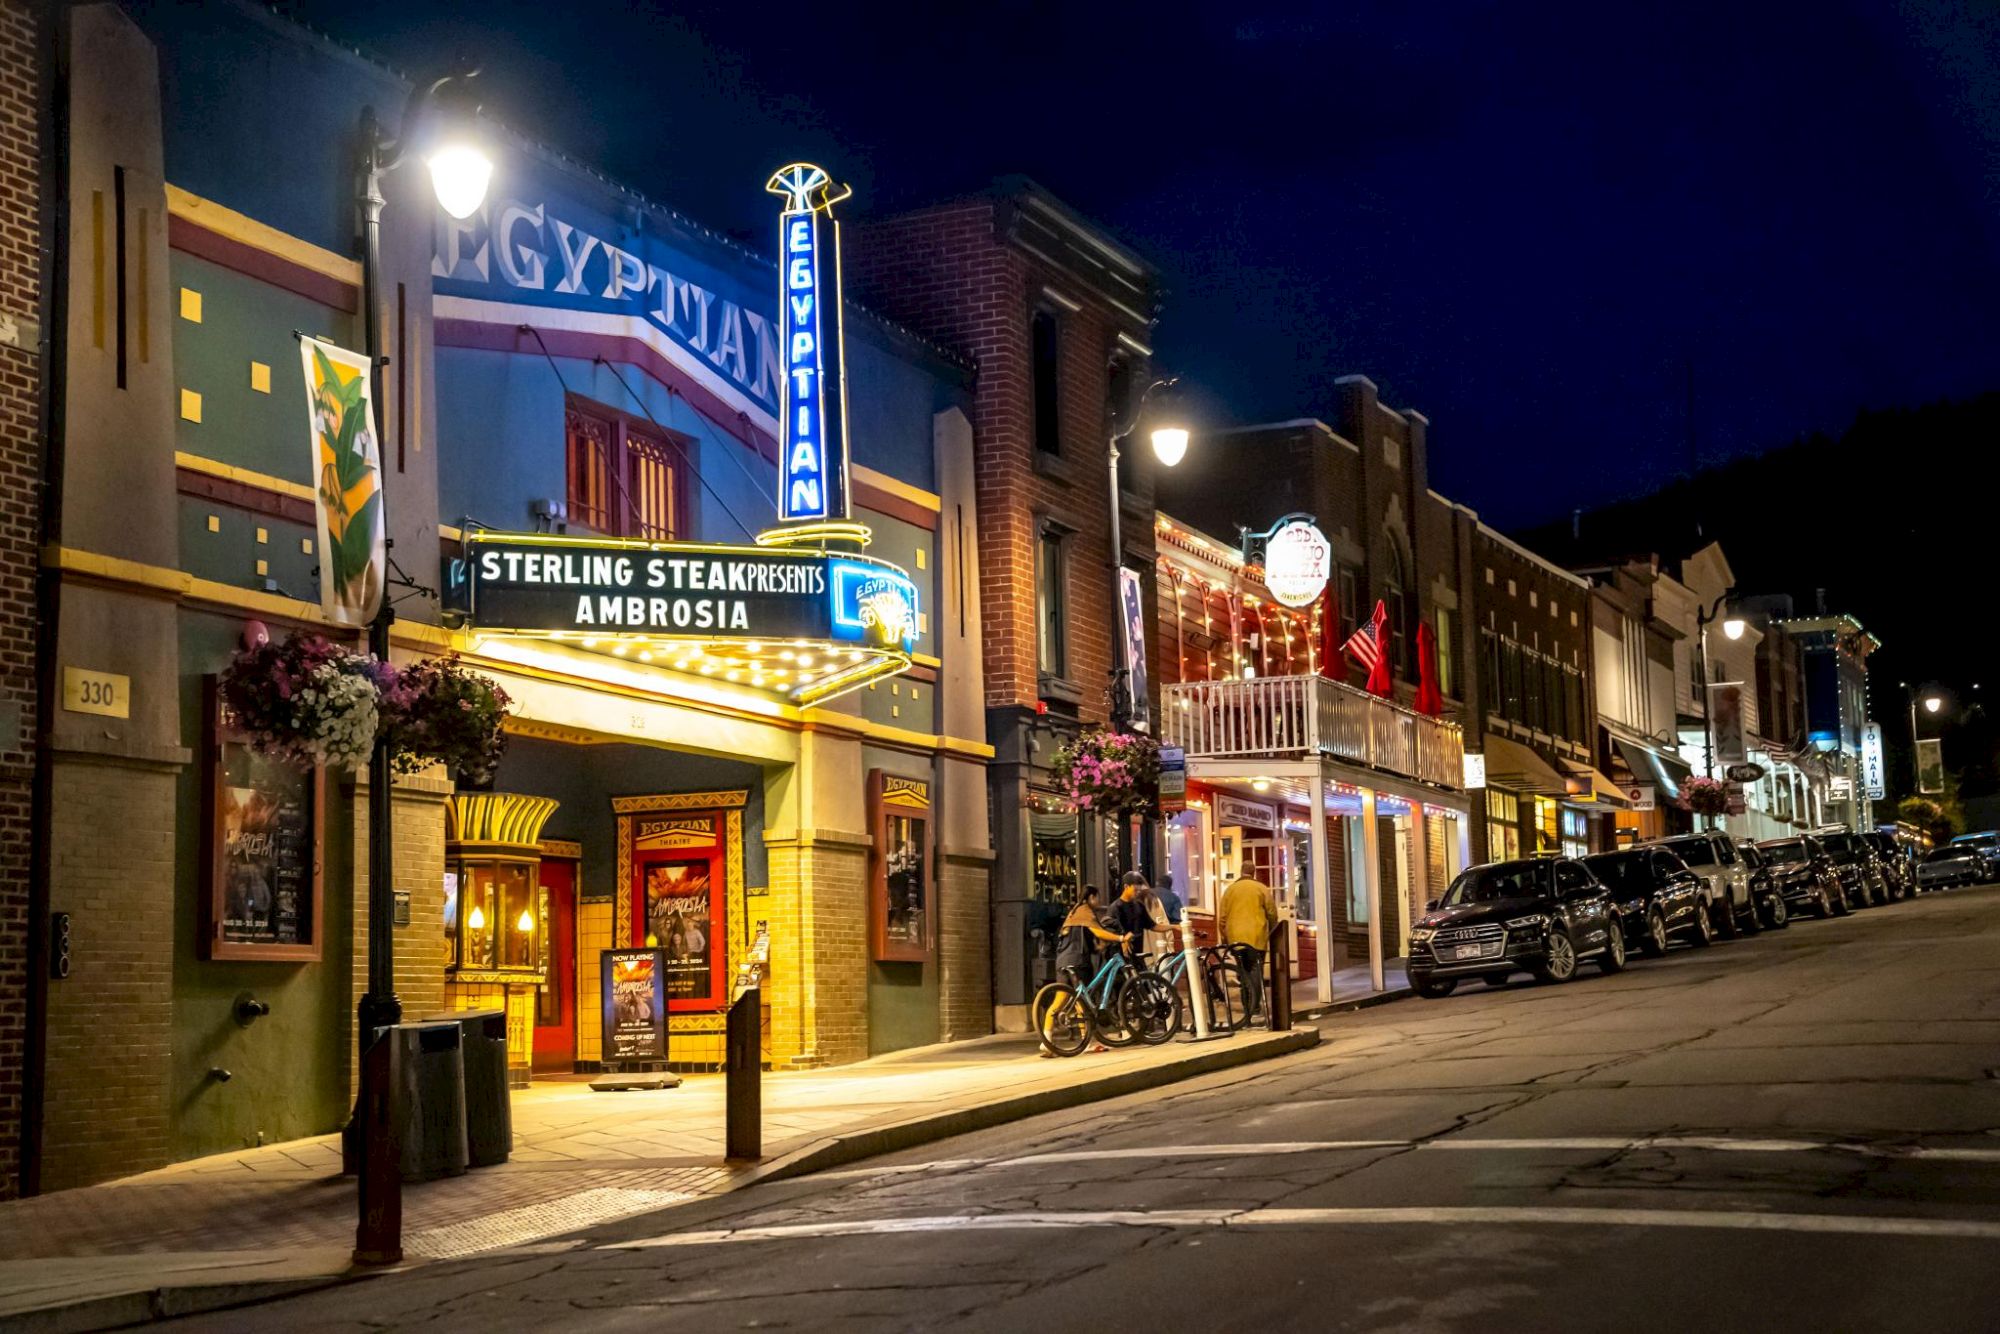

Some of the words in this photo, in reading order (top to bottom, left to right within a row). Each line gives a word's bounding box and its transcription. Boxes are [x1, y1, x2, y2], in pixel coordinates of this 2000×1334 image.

[431, 200, 780, 401] EGYPTIAN
[788, 220, 821, 513] EGYPTIAN
[481, 551, 634, 587] STERLING
[647, 557, 748, 591] STEAK
[747, 564, 826, 594] PRESENTS
[575, 594, 750, 630] AMBROSIA
[81, 680, 114, 706] 330
[1868, 756, 1878, 786] MAIN
[886, 776, 927, 798] EGYPTIAN
[641, 819, 710, 836] EGYPTIAN
[659, 838, 691, 846] THEATRE
[1037, 852, 1071, 876] PARK
[653, 896, 707, 919] AMBROSIA
[630, 953, 654, 961] PLAYING
